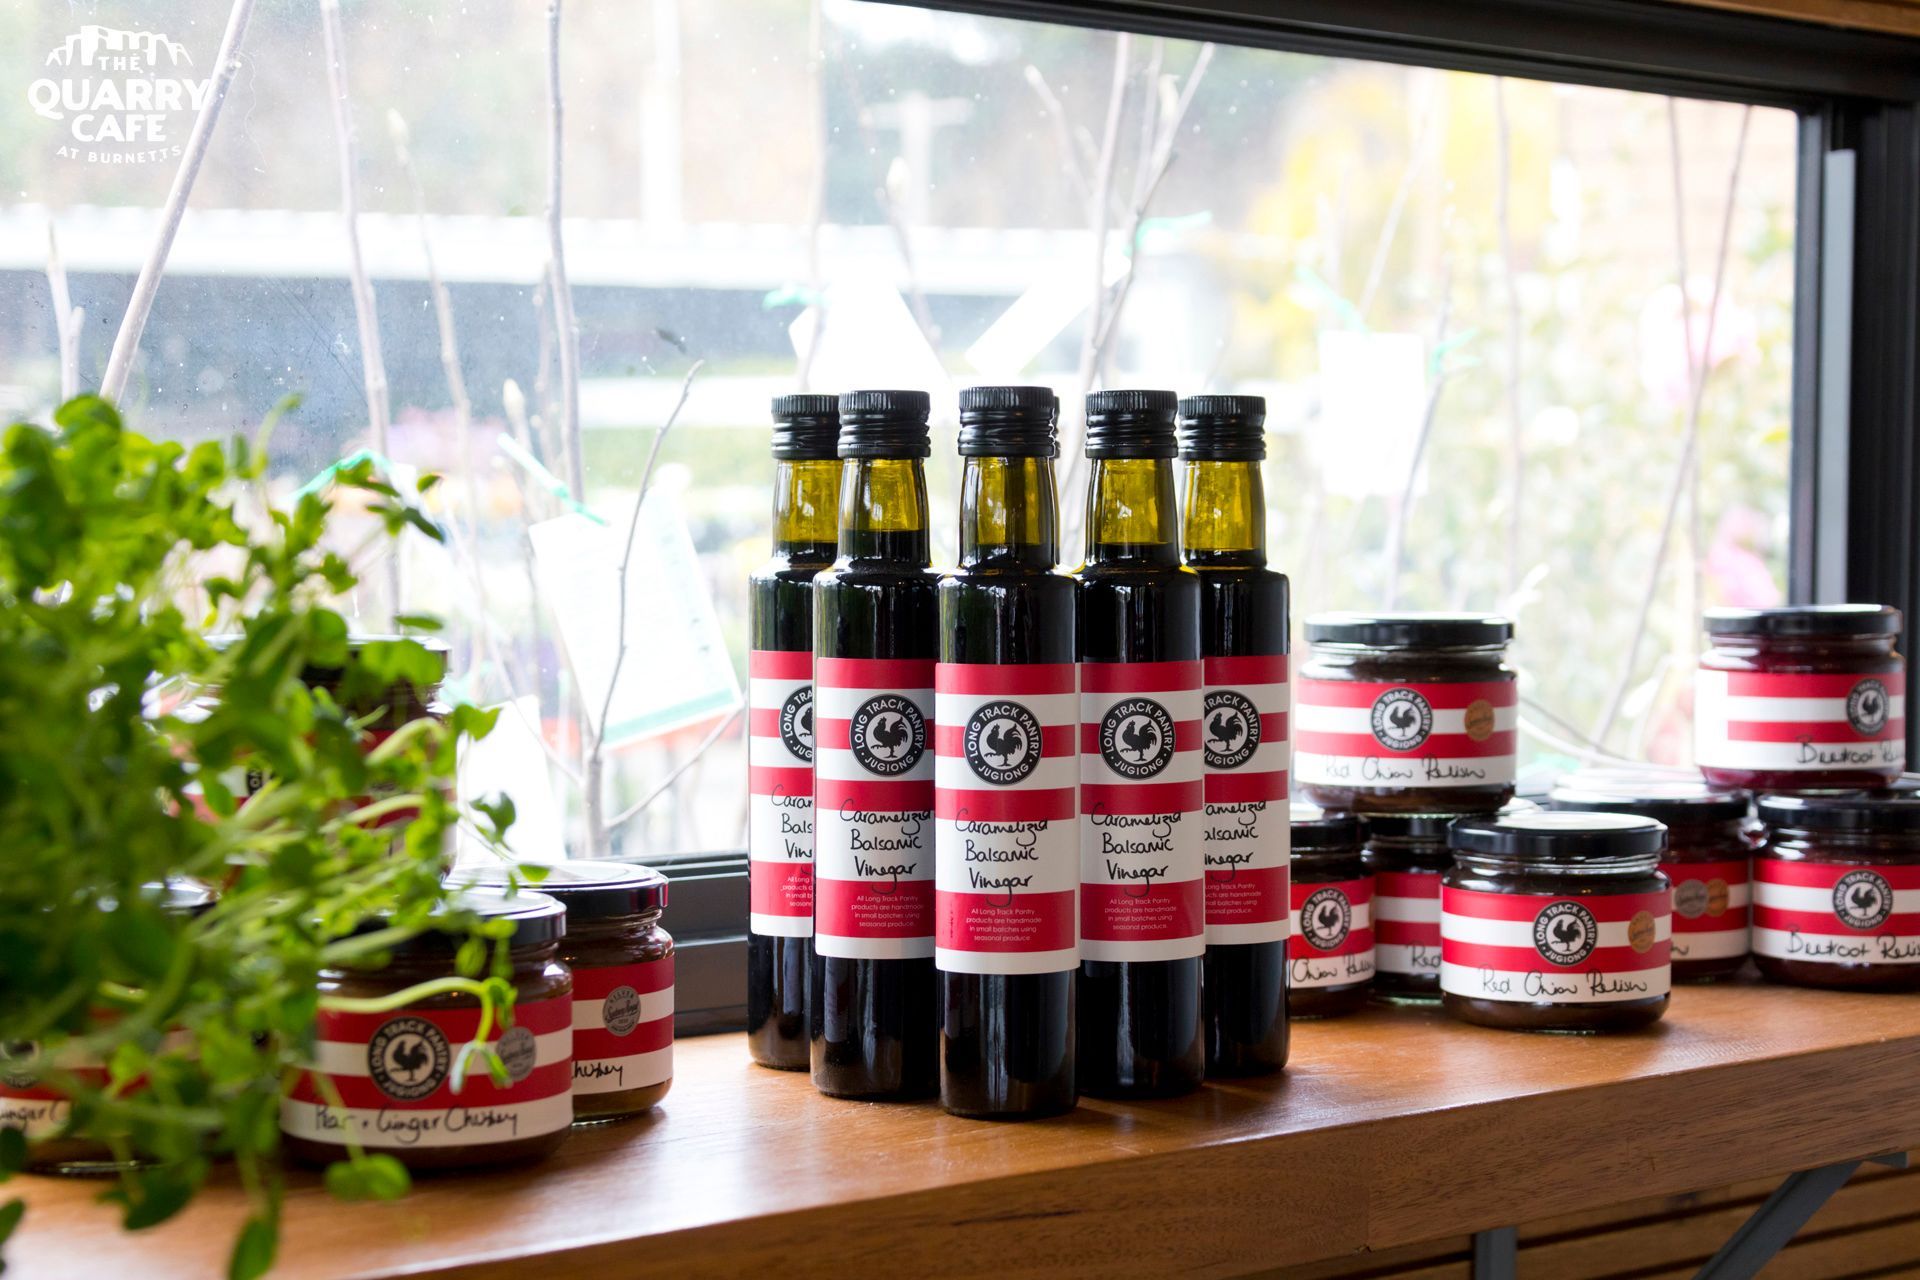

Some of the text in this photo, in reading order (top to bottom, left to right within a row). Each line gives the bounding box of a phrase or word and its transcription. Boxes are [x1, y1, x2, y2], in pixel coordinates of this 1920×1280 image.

[783, 690, 812, 737] LONG TRA
[853, 699, 924, 750] LONG TRACK PANTRY
[1104, 701, 1173, 753] LONG TRACK PANTRY
[1240, 702, 1258, 742] PANTRY
[1373, 703, 1386, 732] LONG
[1383, 690, 1414, 702] TRACK
[1415, 695, 1432, 731] PANTRY
[967, 705, 1040, 758] LONG TRACK PANTRY
[864, 754, 914, 772] JUGIONG
[978, 763, 1029, 782] JUGIONG
[1114, 757, 1165, 776] JUGIONG
[850, 828, 922, 851] Balsamic
[965, 839, 1039, 862] Balsamic
[1102, 832, 1173, 854] Balsamic
[1204, 826, 1259, 841] alsamic
[855, 856, 917, 894] Vinegar
[1106, 859, 1169, 898] Vinegar
[1205, 852, 1253, 882] inegar
[969, 867, 1033, 908] Vinegar
[1837, 883, 1848, 910] LONG
[1845, 872, 1875, 883] TRACK
[1303, 904, 1314, 931] LONG
[1312, 889, 1338, 904] TRACK
[1536, 917, 1549, 946] LONG
[1547, 903, 1579, 917] TRACK
[1579, 909, 1595, 944] PANTRY
[1546, 948, 1587, 963] JUGIONG
[1478, 963, 1512, 993] Red
[383, 1019, 427, 1037] TRACK
[571, 1061, 623, 1087] hutney
